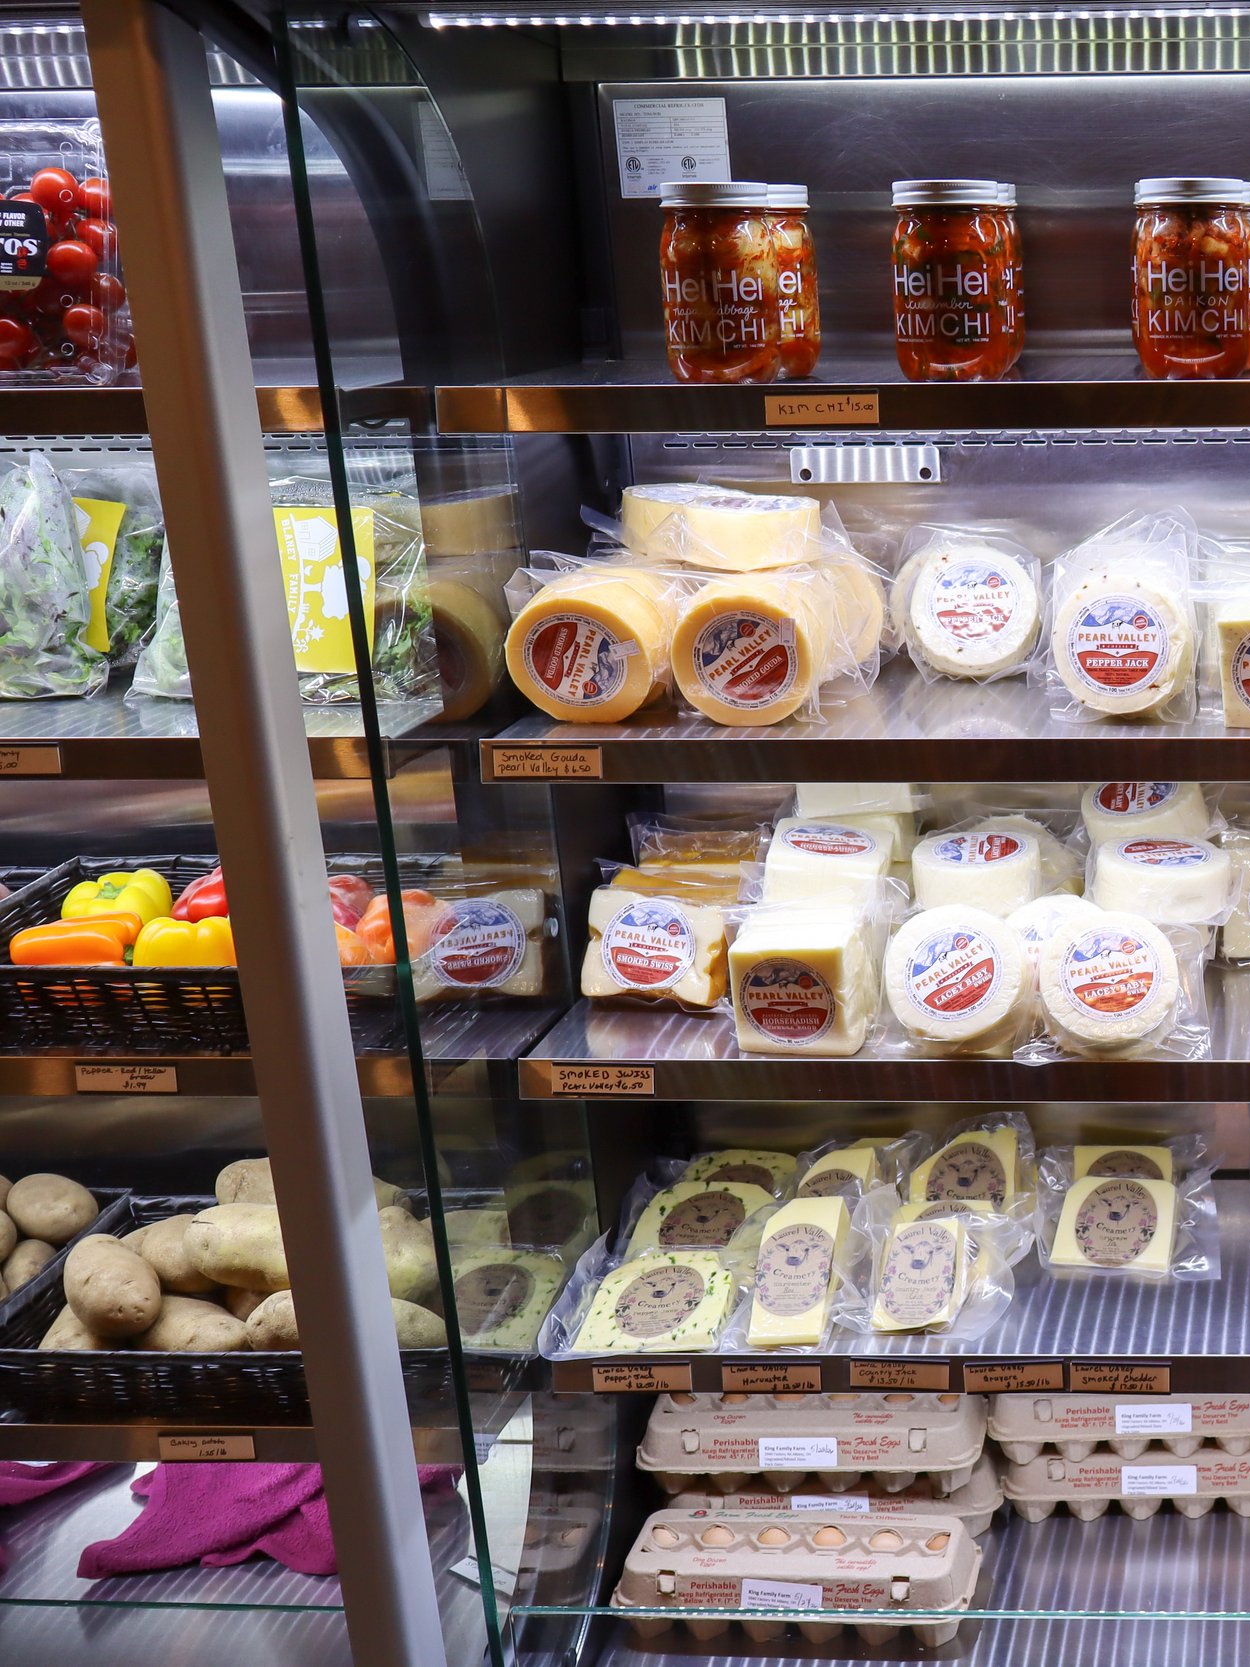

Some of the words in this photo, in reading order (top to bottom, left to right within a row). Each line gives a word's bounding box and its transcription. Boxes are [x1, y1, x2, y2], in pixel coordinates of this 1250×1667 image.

[4, 219, 24, 227] OTHER
[894, 264, 931, 296] Hei
[937, 263, 988, 296] Hei
[1147, 260, 1194, 292] Hei
[1201, 260, 1243, 292] Hei
[665, 270, 706, 303] Hei
[712, 269, 763, 301] Hei
[1164, 295, 1230, 306] DAIKON
[896, 312, 990, 336] KIMCHI
[1148, 309, 1244, 332] KIMCHI
[668, 318, 767, 343] KIMCHI
[281, 518, 296, 561] BLANEY
[287, 573, 299, 614] FAMILY
[1078, 633, 1115, 642] PEARL
[1117, 633, 1157, 642] VALLEY
[579, 629, 597, 663] PEARL
[708, 657, 740, 681] PEARL
[738, 629, 772, 657] VALLEY
[1086, 658, 1123, 667] PEPPER
[1125, 658, 1149, 667] JACK
[760, 655, 783, 674] GOUDA
[567, 662, 588, 698] VALLEY
[501, 752, 544, 762] Smoked
[550, 752, 587, 762] Gouda
[530, 762, 559, 776] Valley
[615, 929, 647, 942] PEARL
[651, 935, 686, 949] VALLEY
[616, 953, 649, 966] SMOKED
[650, 959, 674, 971] SWISS
[915, 969, 948, 992] PEARL
[947, 943, 984, 970] VALLEY
[1069, 967, 1106, 978] PEARL
[1108, 954, 1148, 970] VALLEY
[935, 983, 965, 1005] LACEY
[964, 967, 989, 987] BABY
[1084, 985, 1117, 999] LACEY
[1119, 979, 1147, 994] BABY
[749, 991, 783, 1001] PEARL
[785, 991, 824, 1001] VALLEY
[762, 1017, 819, 1026] HORSERADISH
[615, 1070, 650, 1079] SWISS
[946, 1188, 987, 1201] Creamery
[1095, 1182, 1121, 1196] Laurel
[771, 1227, 800, 1242] Laurel
[896, 1227, 925, 1242] Laurel
[1095, 1221, 1137, 1235] Creamery
[773, 1268, 815, 1280] Creamery
[897, 1271, 939, 1283] Creamery
[637, 1300, 681, 1309] Creamery
[1066, 1407, 1110, 1415] Perishable
[1229, 1400, 1250, 1412] Eggs
[713, 1439, 758, 1447] Perishable
[880, 1436, 901, 1448] Eggs
[1079, 1467, 1121, 1475] Perishable
[739, 1496, 784, 1505] Perishable
[690, 1581, 737, 1590] Perishable
[835, 1584, 860, 1595] Fresh
[862, 1584, 885, 1597] Eggs
